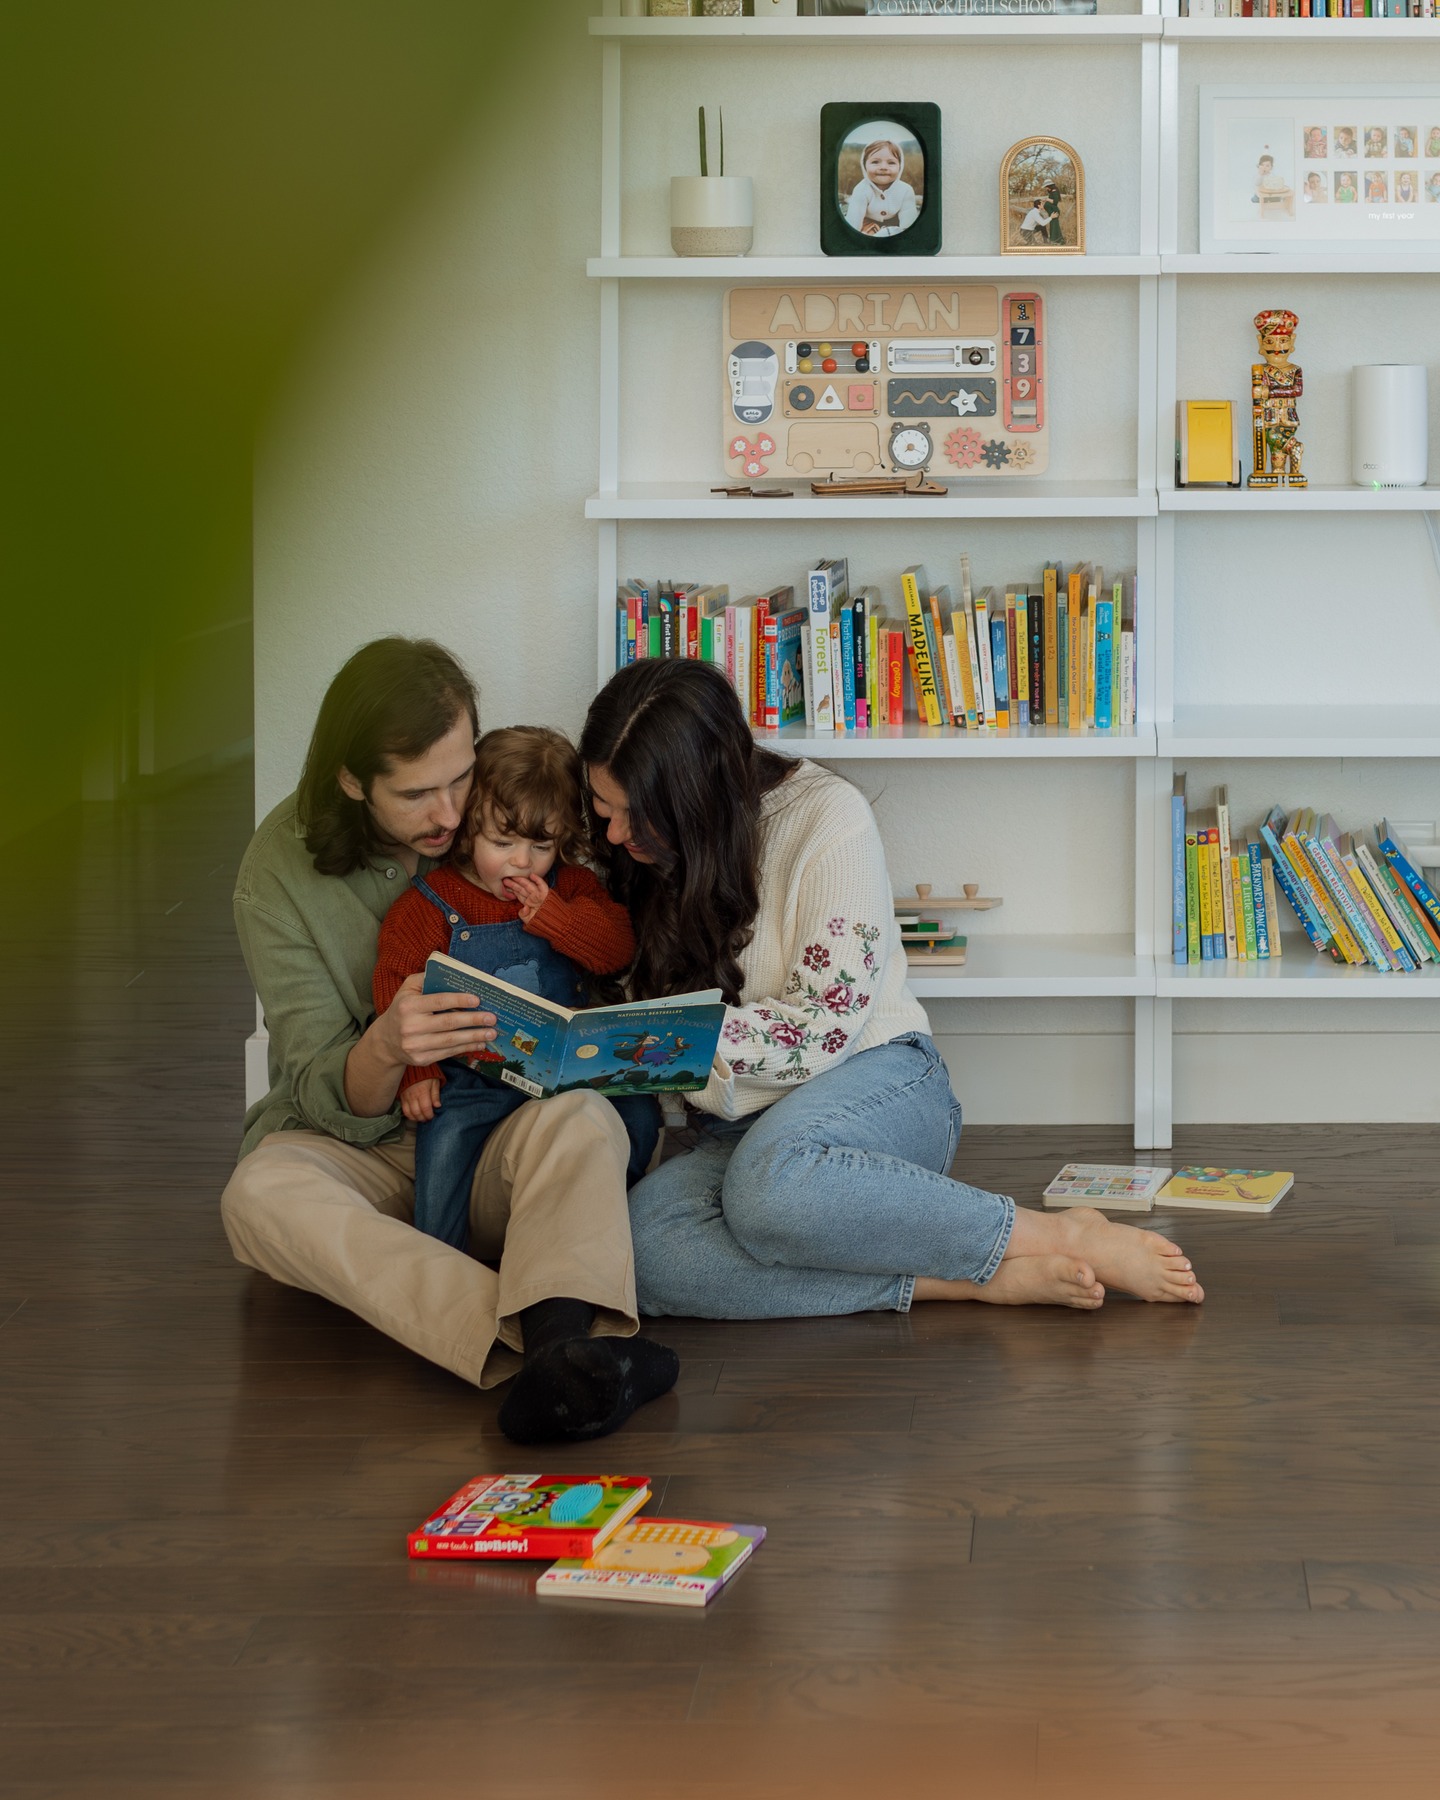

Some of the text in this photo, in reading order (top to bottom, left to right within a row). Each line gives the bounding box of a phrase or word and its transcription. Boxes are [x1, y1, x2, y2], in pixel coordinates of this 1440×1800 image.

[877, 0, 1057, 14] COMMACK HIGH SCHOOL
[769, 292, 960, 333] ADRIAN
[1016, 303, 1030, 321] 1
[1017, 329, 1030, 344] 7
[1017, 353, 1030, 373] 3
[1016, 383, 1031, 399] 9
[664, 614, 671, 622] my
[1048, 634, 1053, 643] Me
[816, 628, 828, 674] Forest
[844, 642, 852, 660] What
[908, 614, 934, 696] MADELINE
[1289, 839, 1311, 875] QUANTUM
[1307, 873, 1326, 903] PHYSICS
[1328, 907, 1342, 927] babies
[1327, 846, 1346, 874] ROCKET
[1342, 872, 1362, 903] SCIENCE
[1362, 908, 1376, 928] babies
[1375, 872, 1383, 883] Brown
[1386, 891, 1394, 902] Brown
[1405, 872, 1414, 881] I
[1286, 870, 1298, 886] BABY
[1295, 885, 1309, 905] SHARK
[1312, 846, 1369, 939] GENERAL RELATIVITY for babies
[1251, 863, 1266, 935] BARNYARD DANCE!
[1398, 898, 1410, 913] WHOSE
[1242, 887, 1254, 942] Little Pookie
[1322, 912, 1336, 932] Nose!
[1361, 886, 1396, 945] Pacifiers Are Not Forever
[617, 1008, 683, 1018] NATIONAL BESTSELLER
[578, 1016, 716, 1038] Room on the Broom
